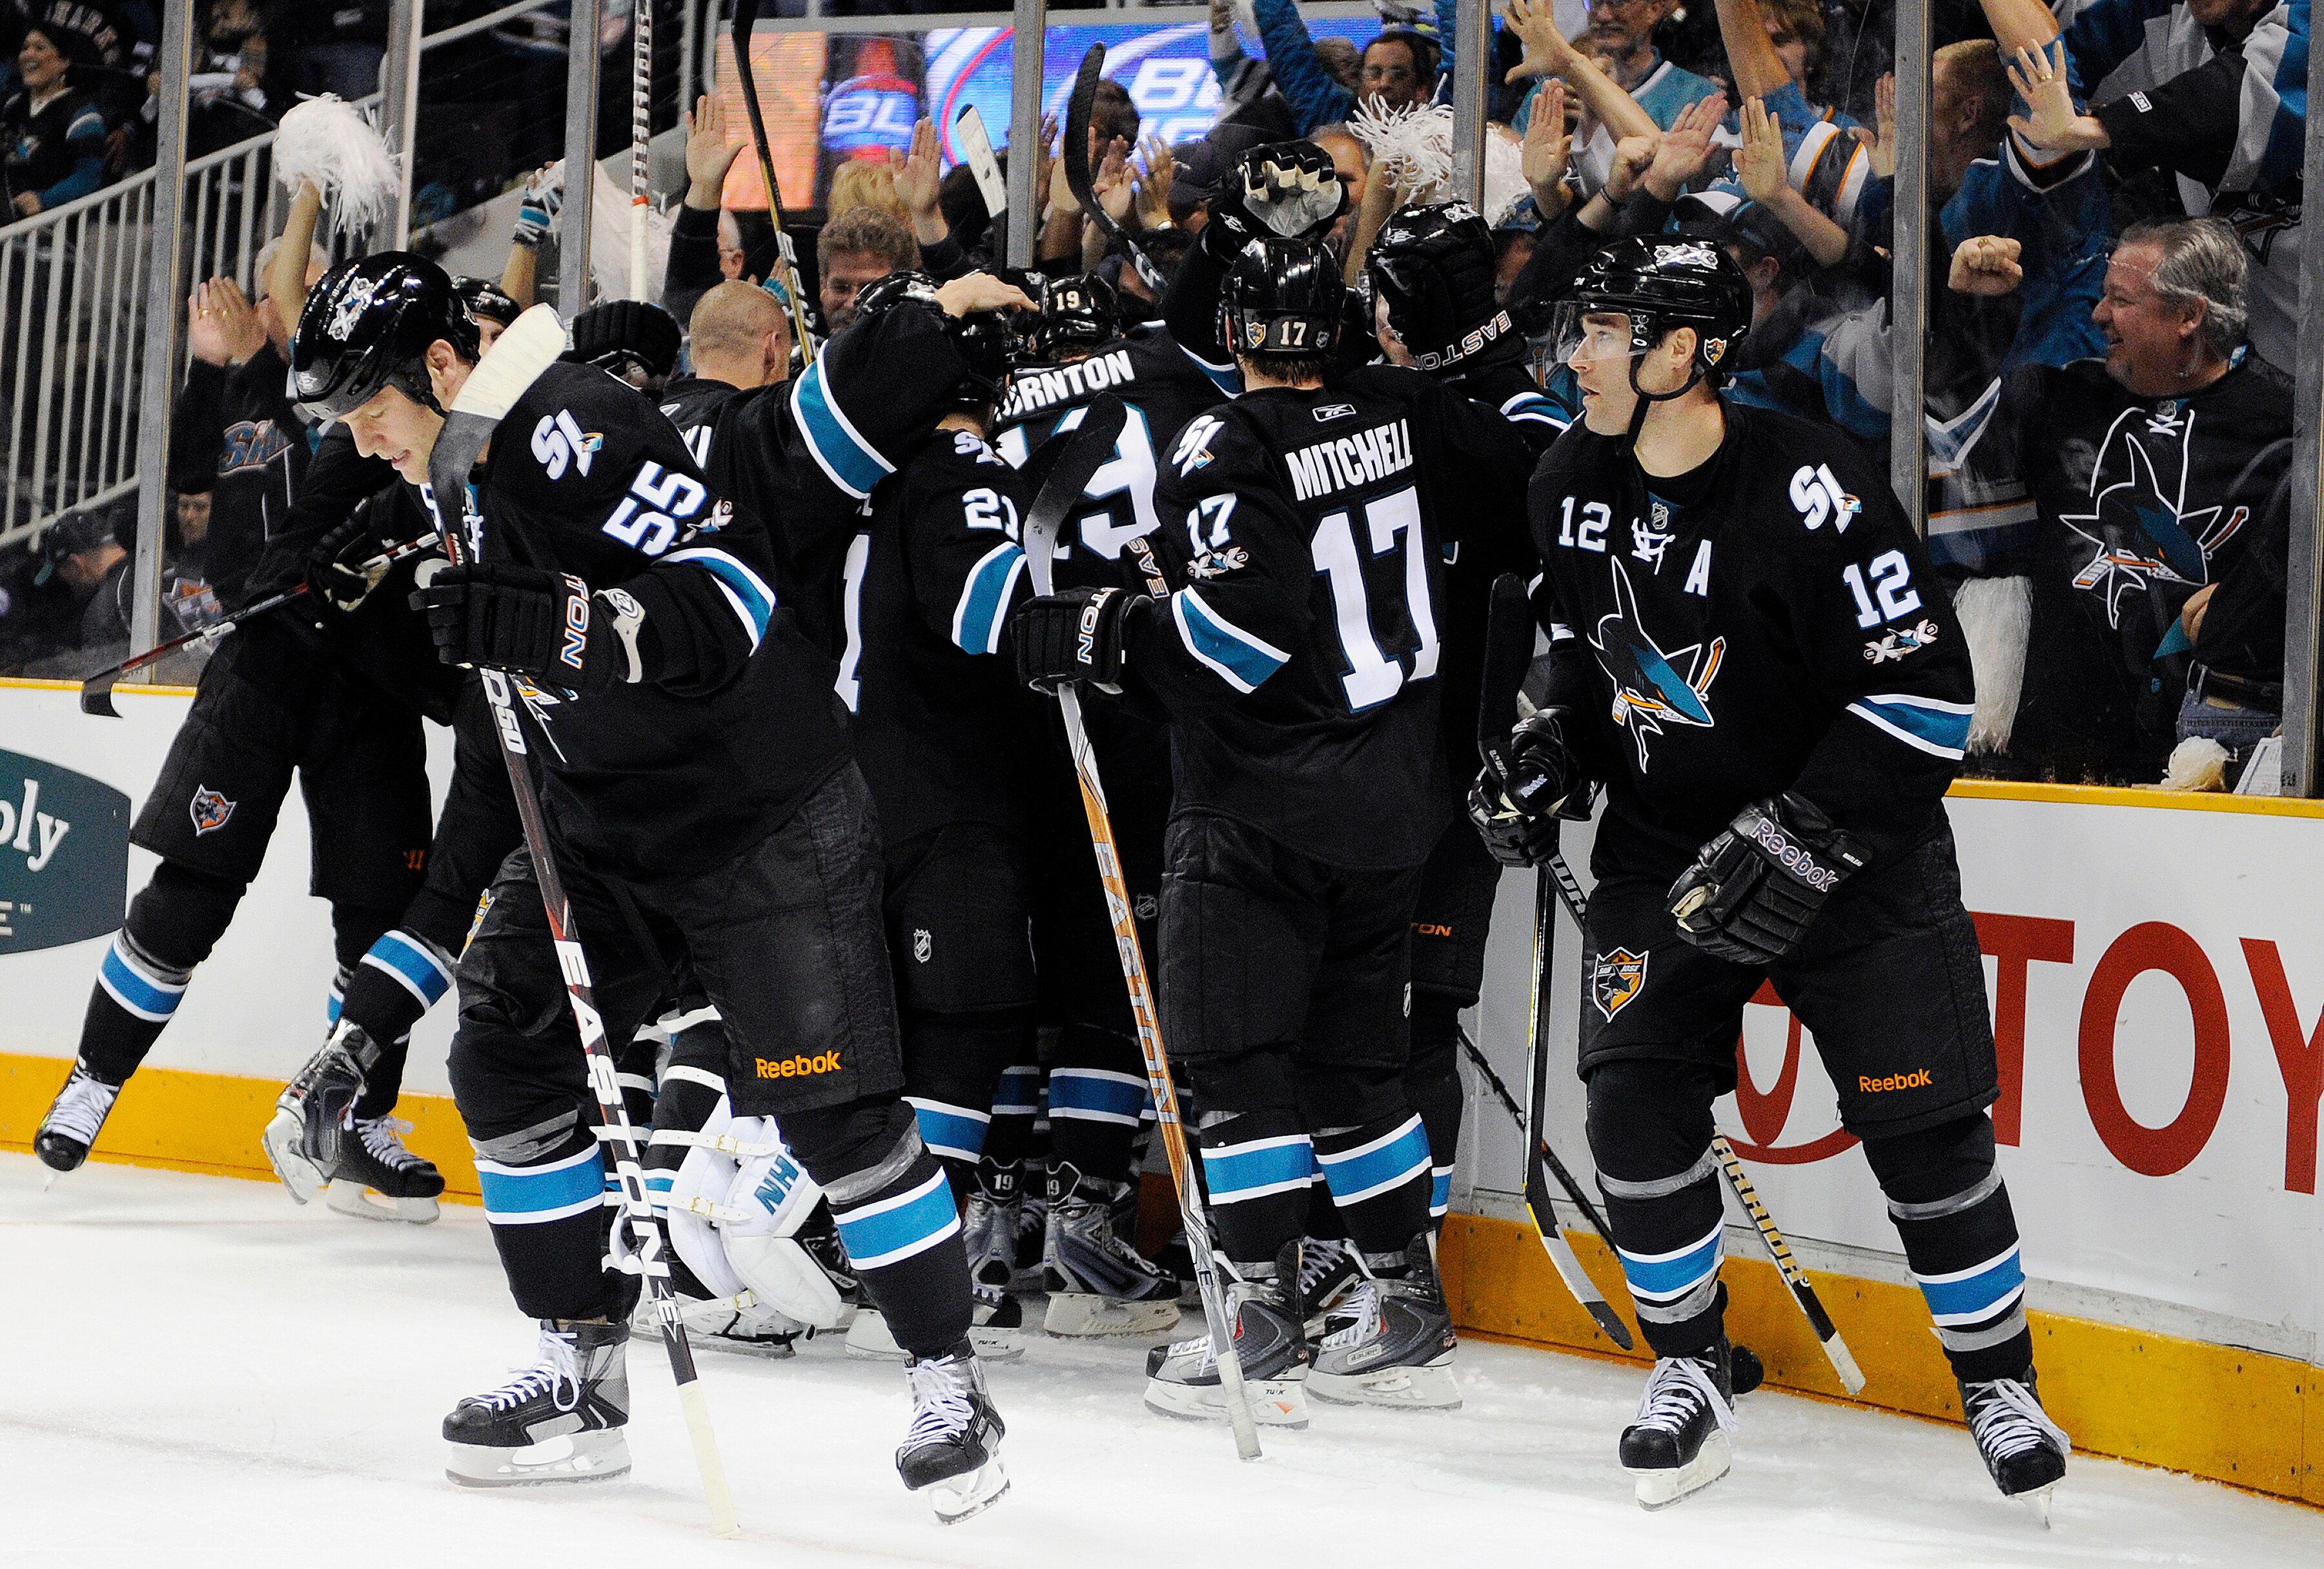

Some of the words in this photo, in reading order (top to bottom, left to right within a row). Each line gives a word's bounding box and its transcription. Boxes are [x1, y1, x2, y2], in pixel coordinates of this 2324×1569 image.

[1056, 290, 1080, 311] 19
[1280, 321, 1307, 346] 17
[1285, 418, 1413, 501] MITCHELL
[601, 460, 708, 557] 55
[1187, 492, 1238, 559] 17
[1558, 495, 1612, 553] 12
[1311, 486, 1440, 709] 17
[1684, 538, 1712, 597] A
[1842, 549, 1923, 630] 12
[1750, 817, 1839, 892] Reebok
[1094, 843, 1179, 1123] EASTON
[755, 1050, 841, 1079] Reebok
[1859, 1068, 1933, 1092] Reebok
[555, 940, 671, 1278] EASTON
[994, 1173, 1014, 1190] 19
